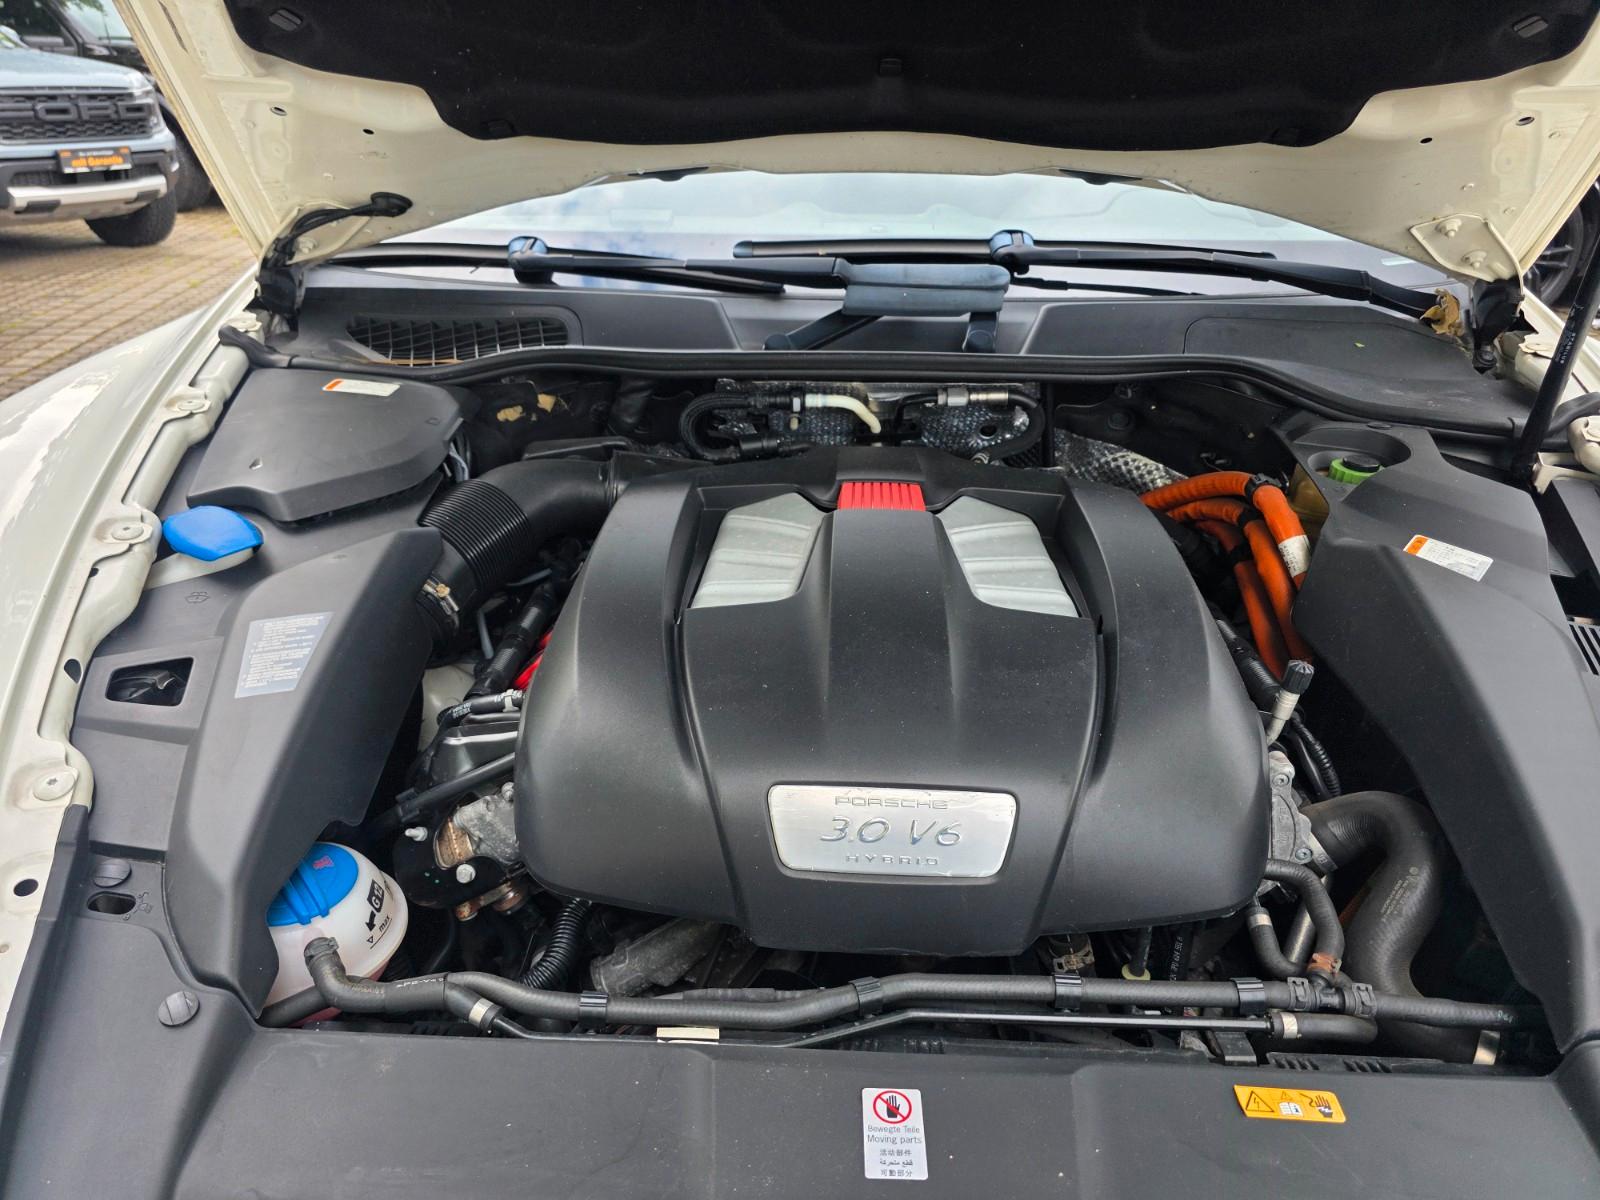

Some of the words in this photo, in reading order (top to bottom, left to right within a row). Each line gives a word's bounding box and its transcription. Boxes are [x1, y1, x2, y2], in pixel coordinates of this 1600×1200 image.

[834, 795, 948, 810] PORSCHE
[819, 815, 891, 844] 3.0
[909, 819, 963, 847] V6
[845, 854, 939, 866] HYBRID
[379, 914, 390, 932] max
[867, 1125, 901, 1134] Bewegte
[903, 1125, 920, 1133] Teile
[867, 1135, 898, 1145] Moving
[900, 1136, 922, 1144] parts
